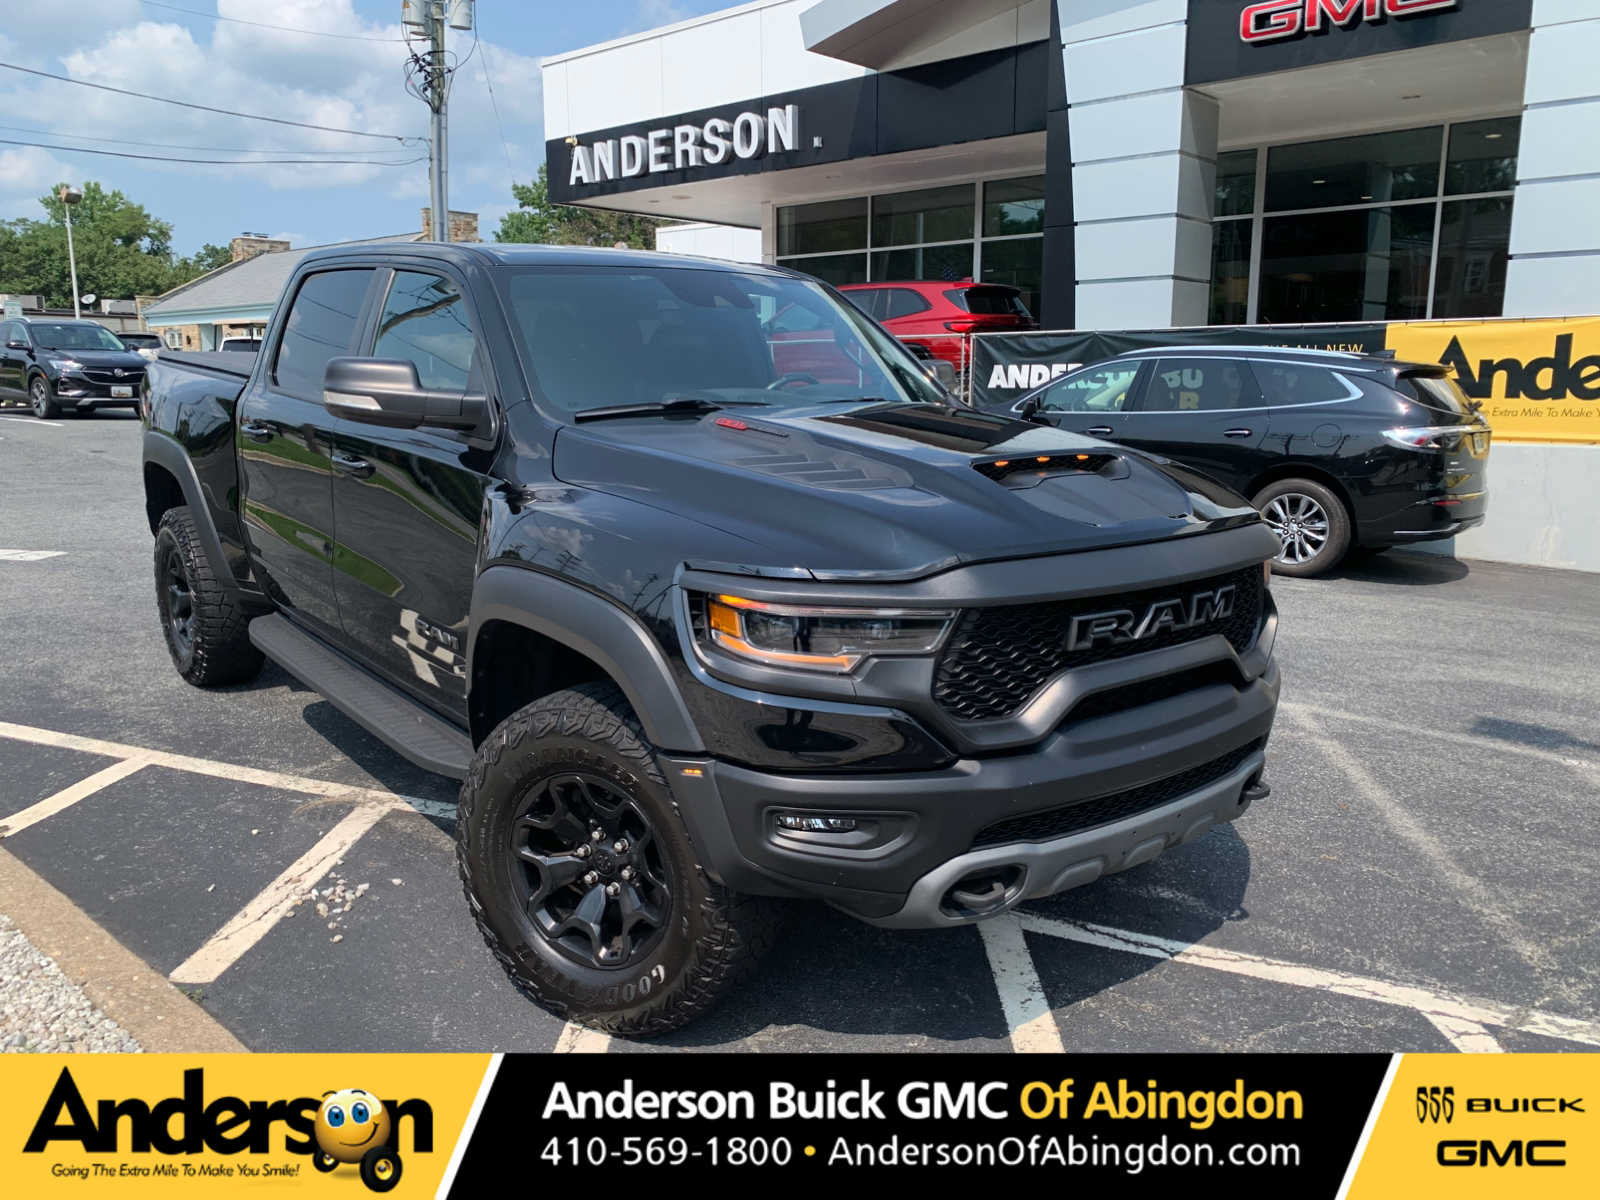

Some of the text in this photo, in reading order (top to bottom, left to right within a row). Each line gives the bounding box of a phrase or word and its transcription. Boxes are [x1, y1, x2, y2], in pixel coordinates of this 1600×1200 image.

[569, 104, 798, 185] ANDERSON
[1520, 407, 1543, 417] Mile
[1546, 407, 1559, 417] To
[1561, 407, 1593, 417] Make
[1067, 585, 1236, 651] RAM
